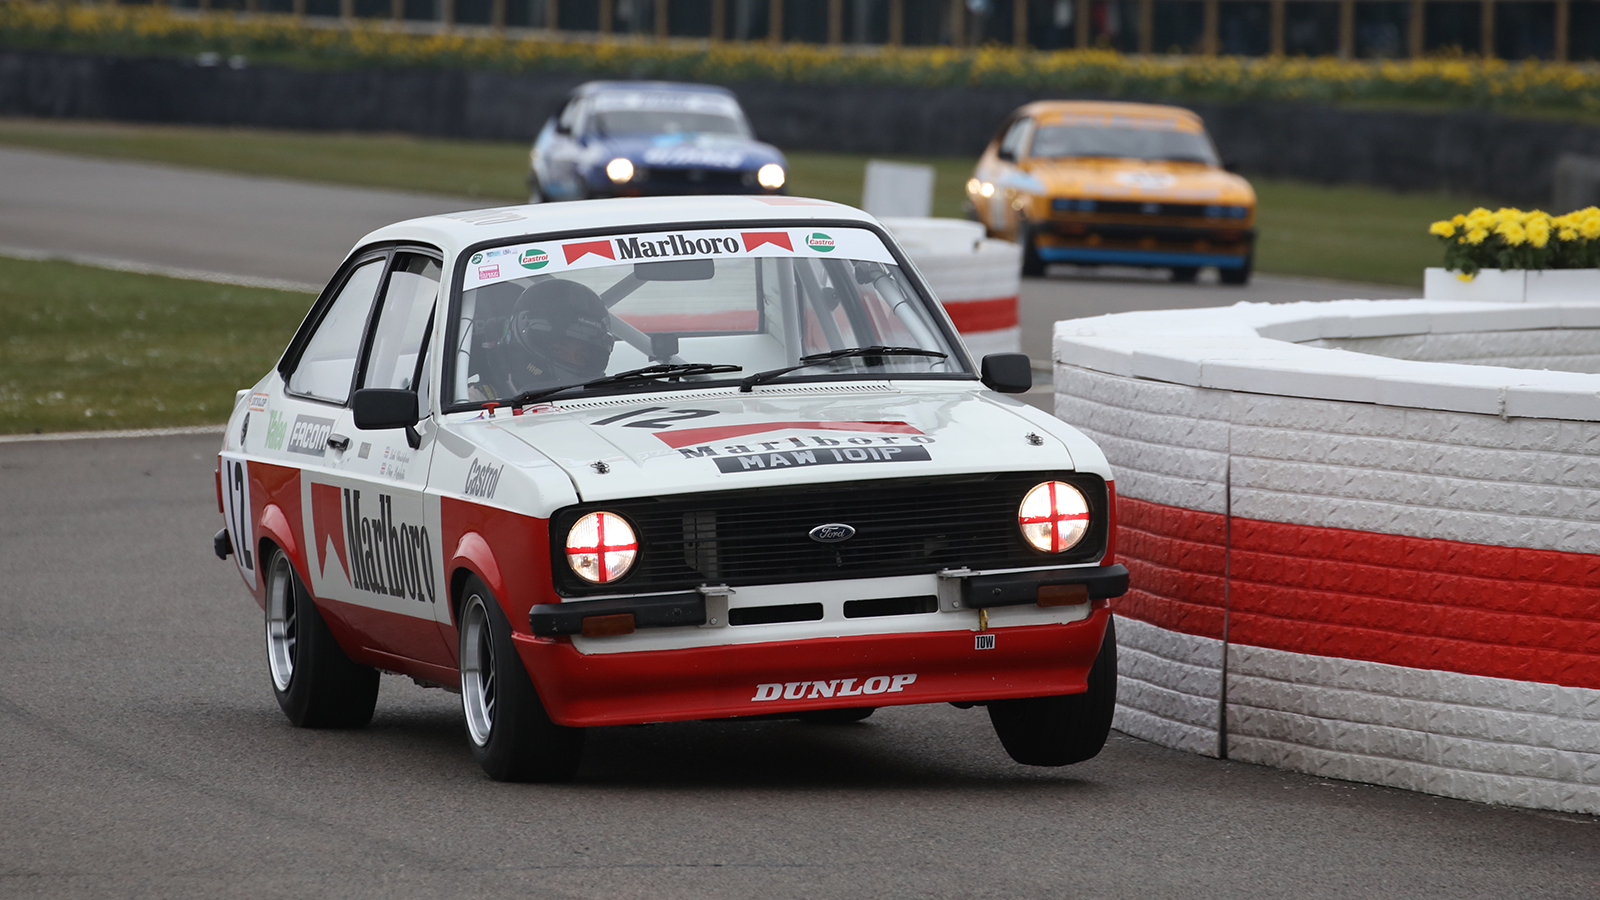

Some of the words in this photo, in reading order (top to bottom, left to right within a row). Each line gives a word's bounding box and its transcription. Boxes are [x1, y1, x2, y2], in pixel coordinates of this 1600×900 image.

[615, 235, 739, 260] Marlboro
[809, 238, 835, 246] Castrol
[522, 254, 549, 264] Castrol
[590, 407, 720, 429] 12
[290, 421, 330, 451] FACOM
[678, 434, 936, 460] Marlboro
[742, 452, 816, 470] MAW
[834, 446, 902, 462] 101P
[465, 457, 505, 499] Castrol
[226, 460, 254, 570] 12
[344, 487, 436, 604] Marlboro
[819, 527, 846, 539] Ford
[976, 635, 994, 649] TOW
[751, 673, 917, 701] DUNLOP
